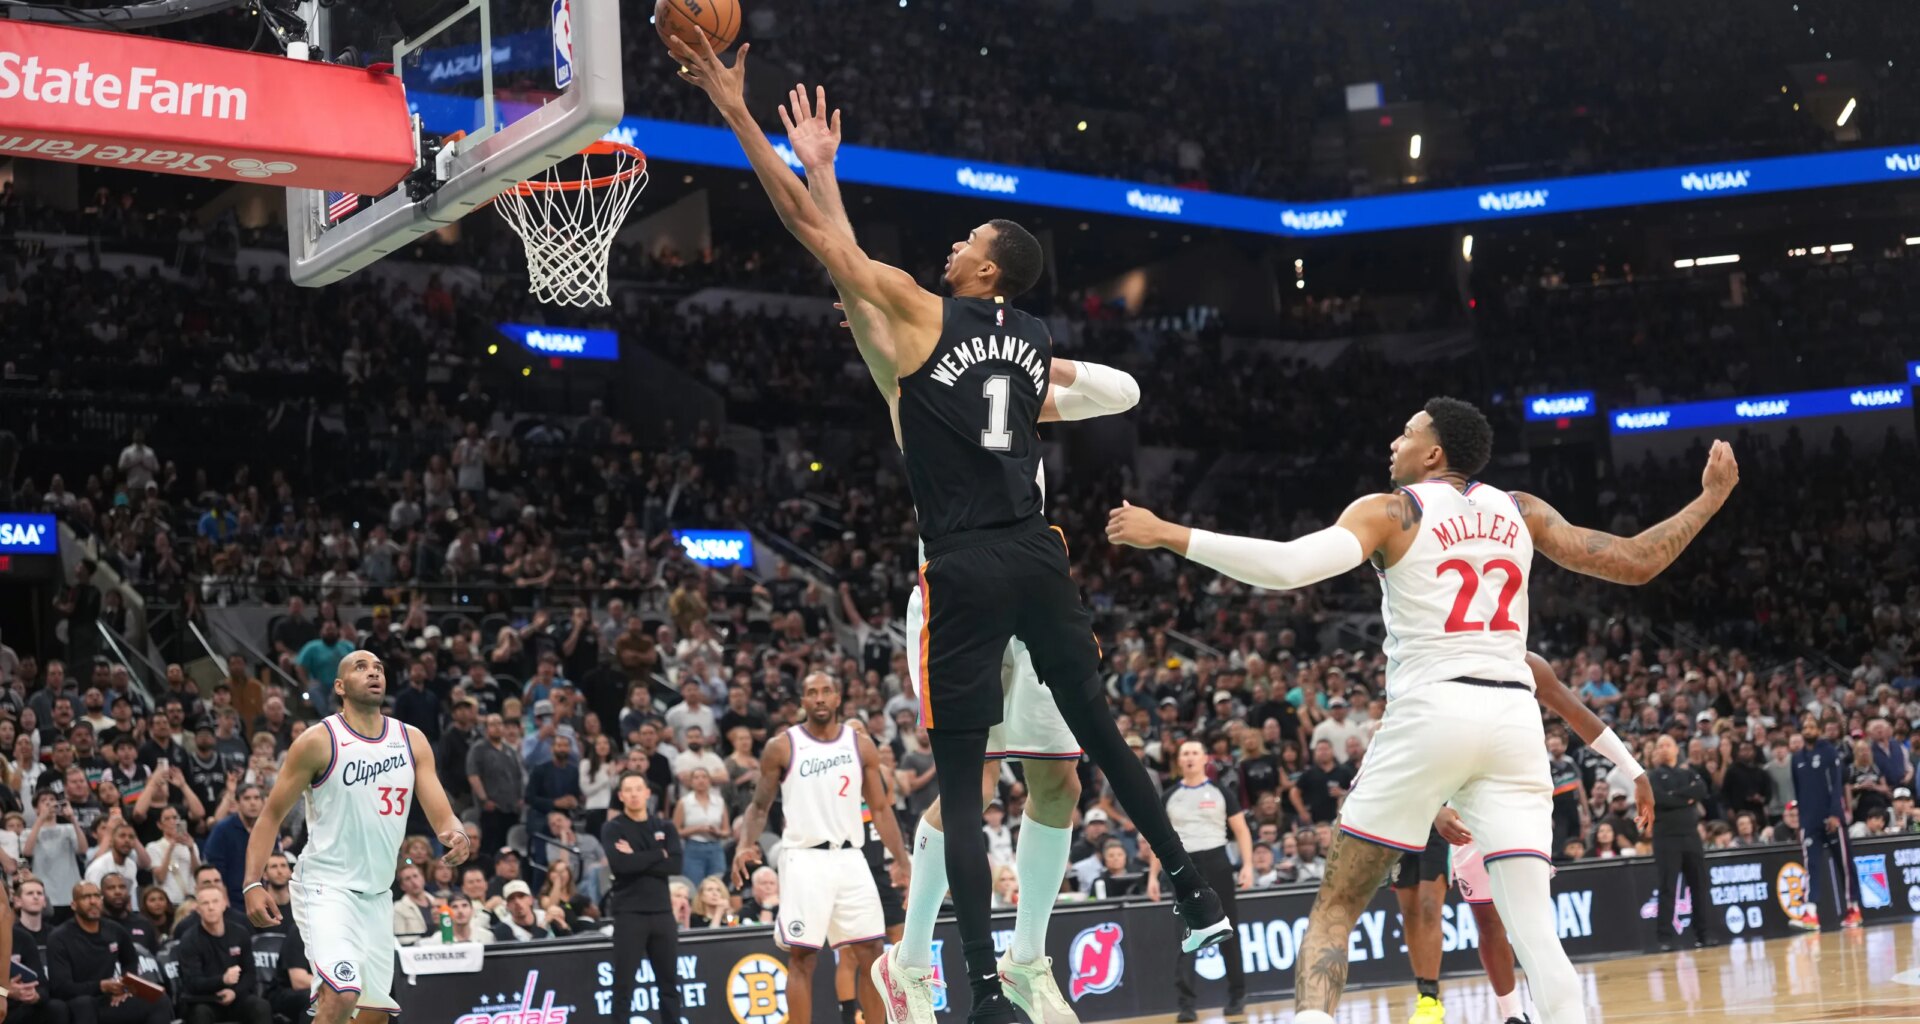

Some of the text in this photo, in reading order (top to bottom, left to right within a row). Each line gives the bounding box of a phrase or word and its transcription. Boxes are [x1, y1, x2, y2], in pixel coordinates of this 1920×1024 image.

[1703, 170, 1748, 190] USAA
[1501, 190, 1546, 209] USAA
[1301, 210, 1344, 229] USAA
[930, 335, 1045, 396] WEMBANYAMA
[1549, 397, 1586, 414] USAA
[1870, 389, 1901, 405] USAA
[981, 374, 1013, 451] 1
[1754, 400, 1787, 417] USAA
[1633, 412, 1668, 428] USAA
[1432, 513, 1519, 551] MILLER
[1436, 558, 1523, 633] 22
[342, 753, 407, 786] Clippers
[800, 754, 853, 777] Clippers
[838, 775, 850, 797] 2
[378, 786, 408, 816] 33
[1710, 863, 1762, 885] SATURDAY
[414, 952, 467, 962] GATORADE
